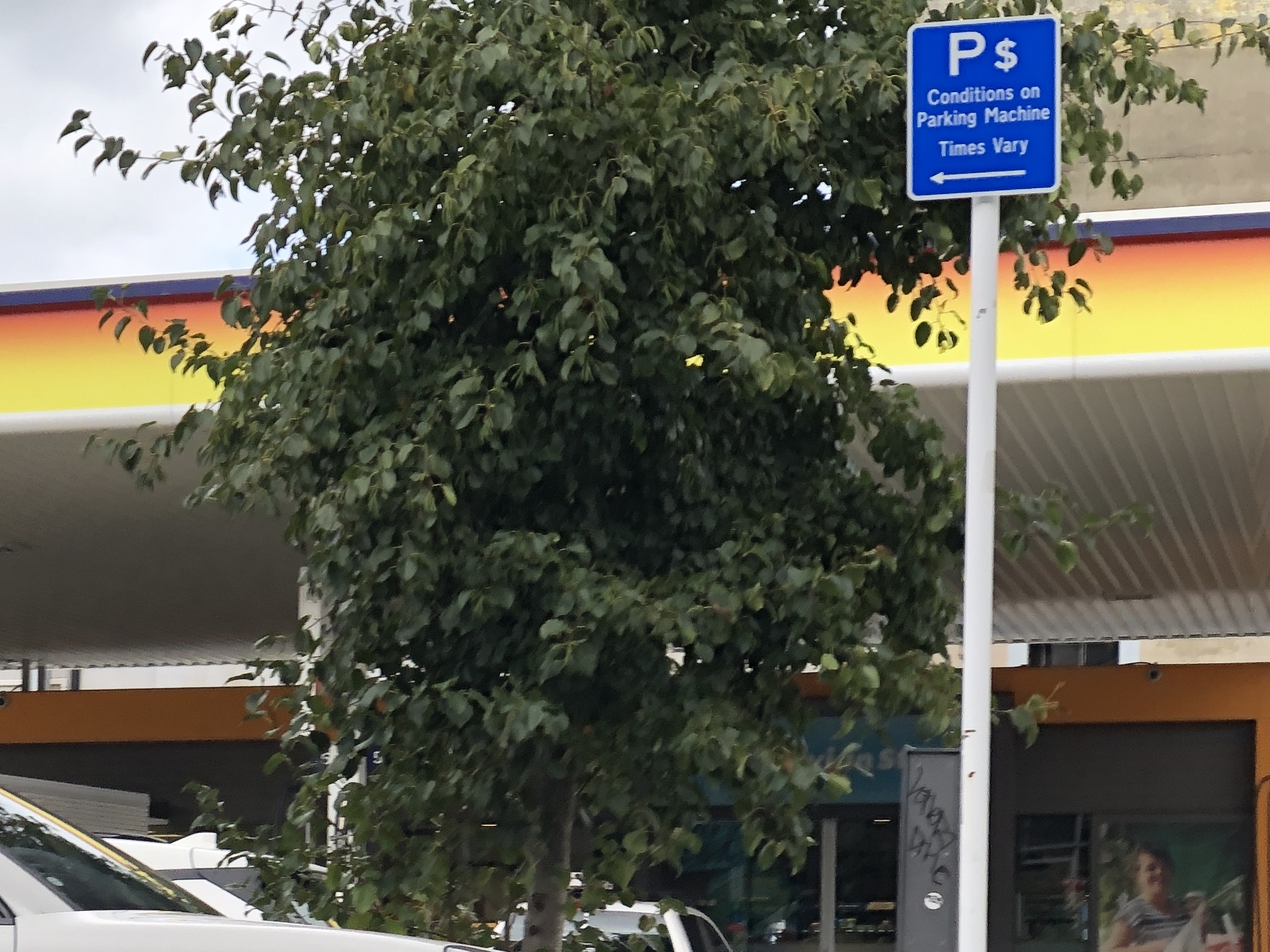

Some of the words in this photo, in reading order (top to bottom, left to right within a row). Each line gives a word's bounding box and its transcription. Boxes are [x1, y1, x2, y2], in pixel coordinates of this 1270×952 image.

[949, 31, 986, 76] P
[994, 37, 1019, 72] $
[927, 86, 1014, 105] Conditions
[1020, 85, 1041, 99] on
[917, 110, 977, 128] Parking
[984, 105, 1051, 124] Machine
[938, 140, 986, 157] Times
[992, 137, 1029, 156] Vary
